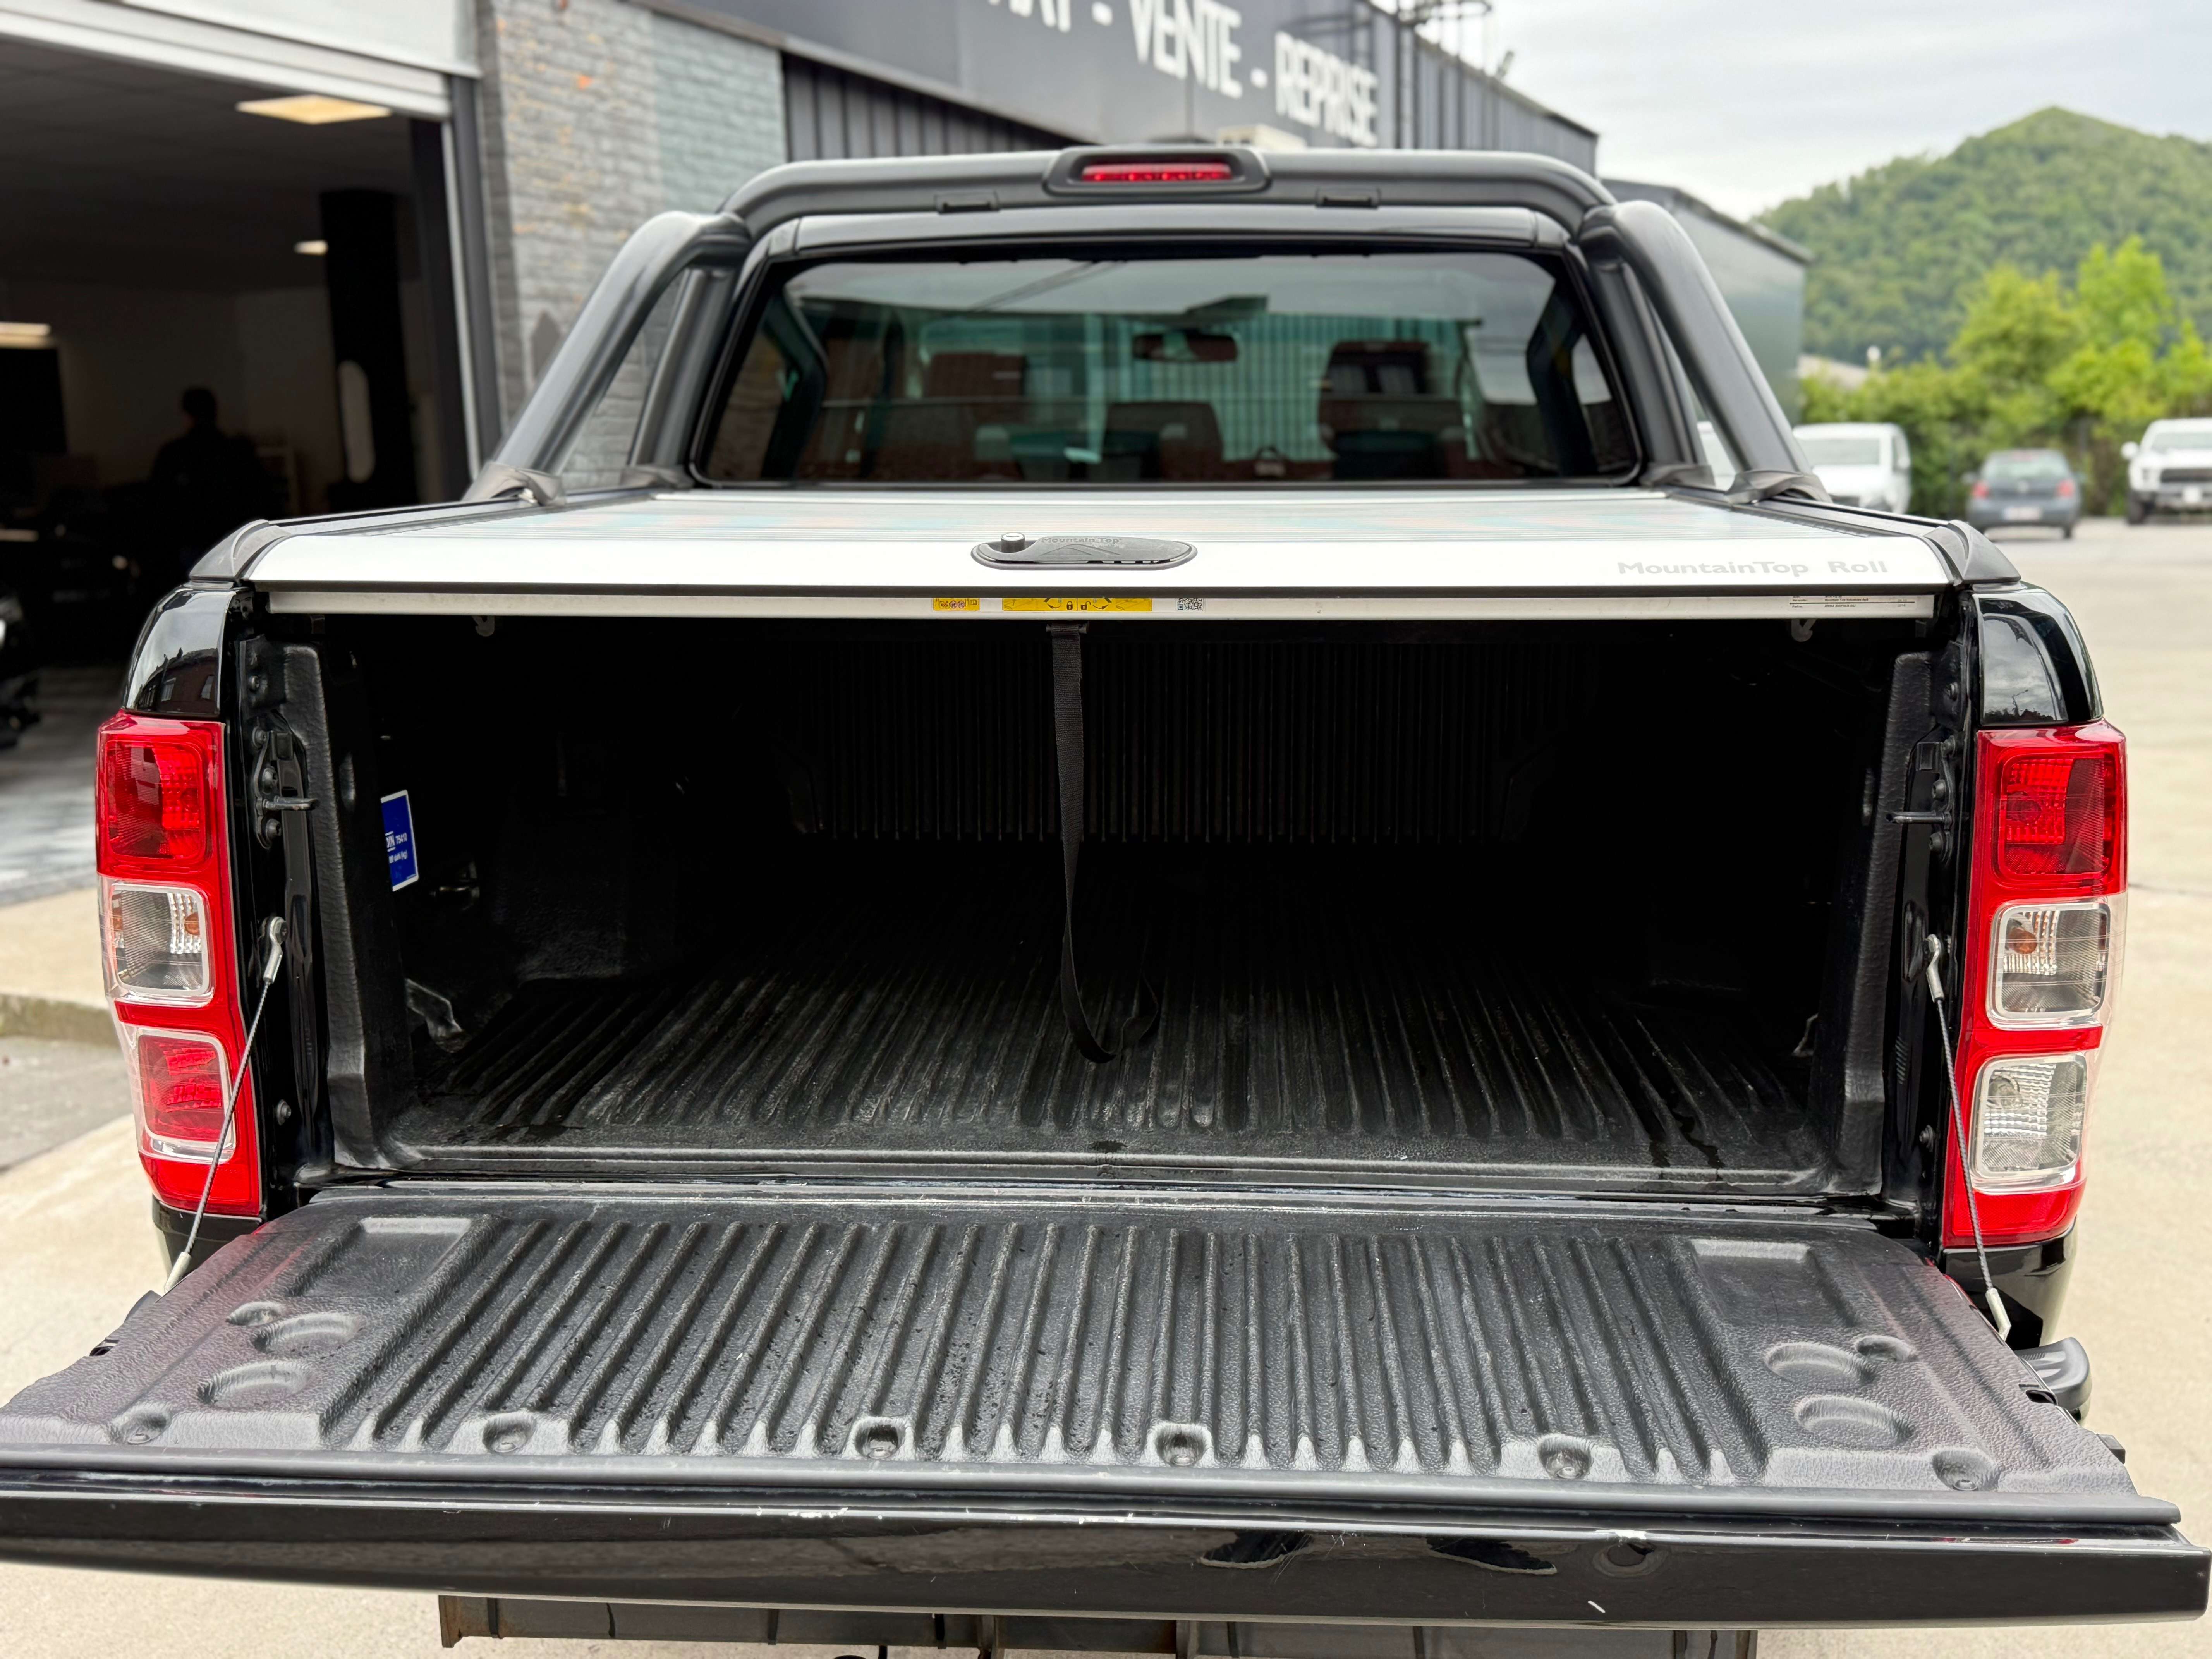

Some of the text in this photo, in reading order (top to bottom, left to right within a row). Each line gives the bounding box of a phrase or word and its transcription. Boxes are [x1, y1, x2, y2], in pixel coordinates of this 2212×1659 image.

[1127, 0, 1242, 99] VENTE
[1275, 30, 1378, 147] REPRISE
[1617, 560, 1889, 577] MountainTop Roll
